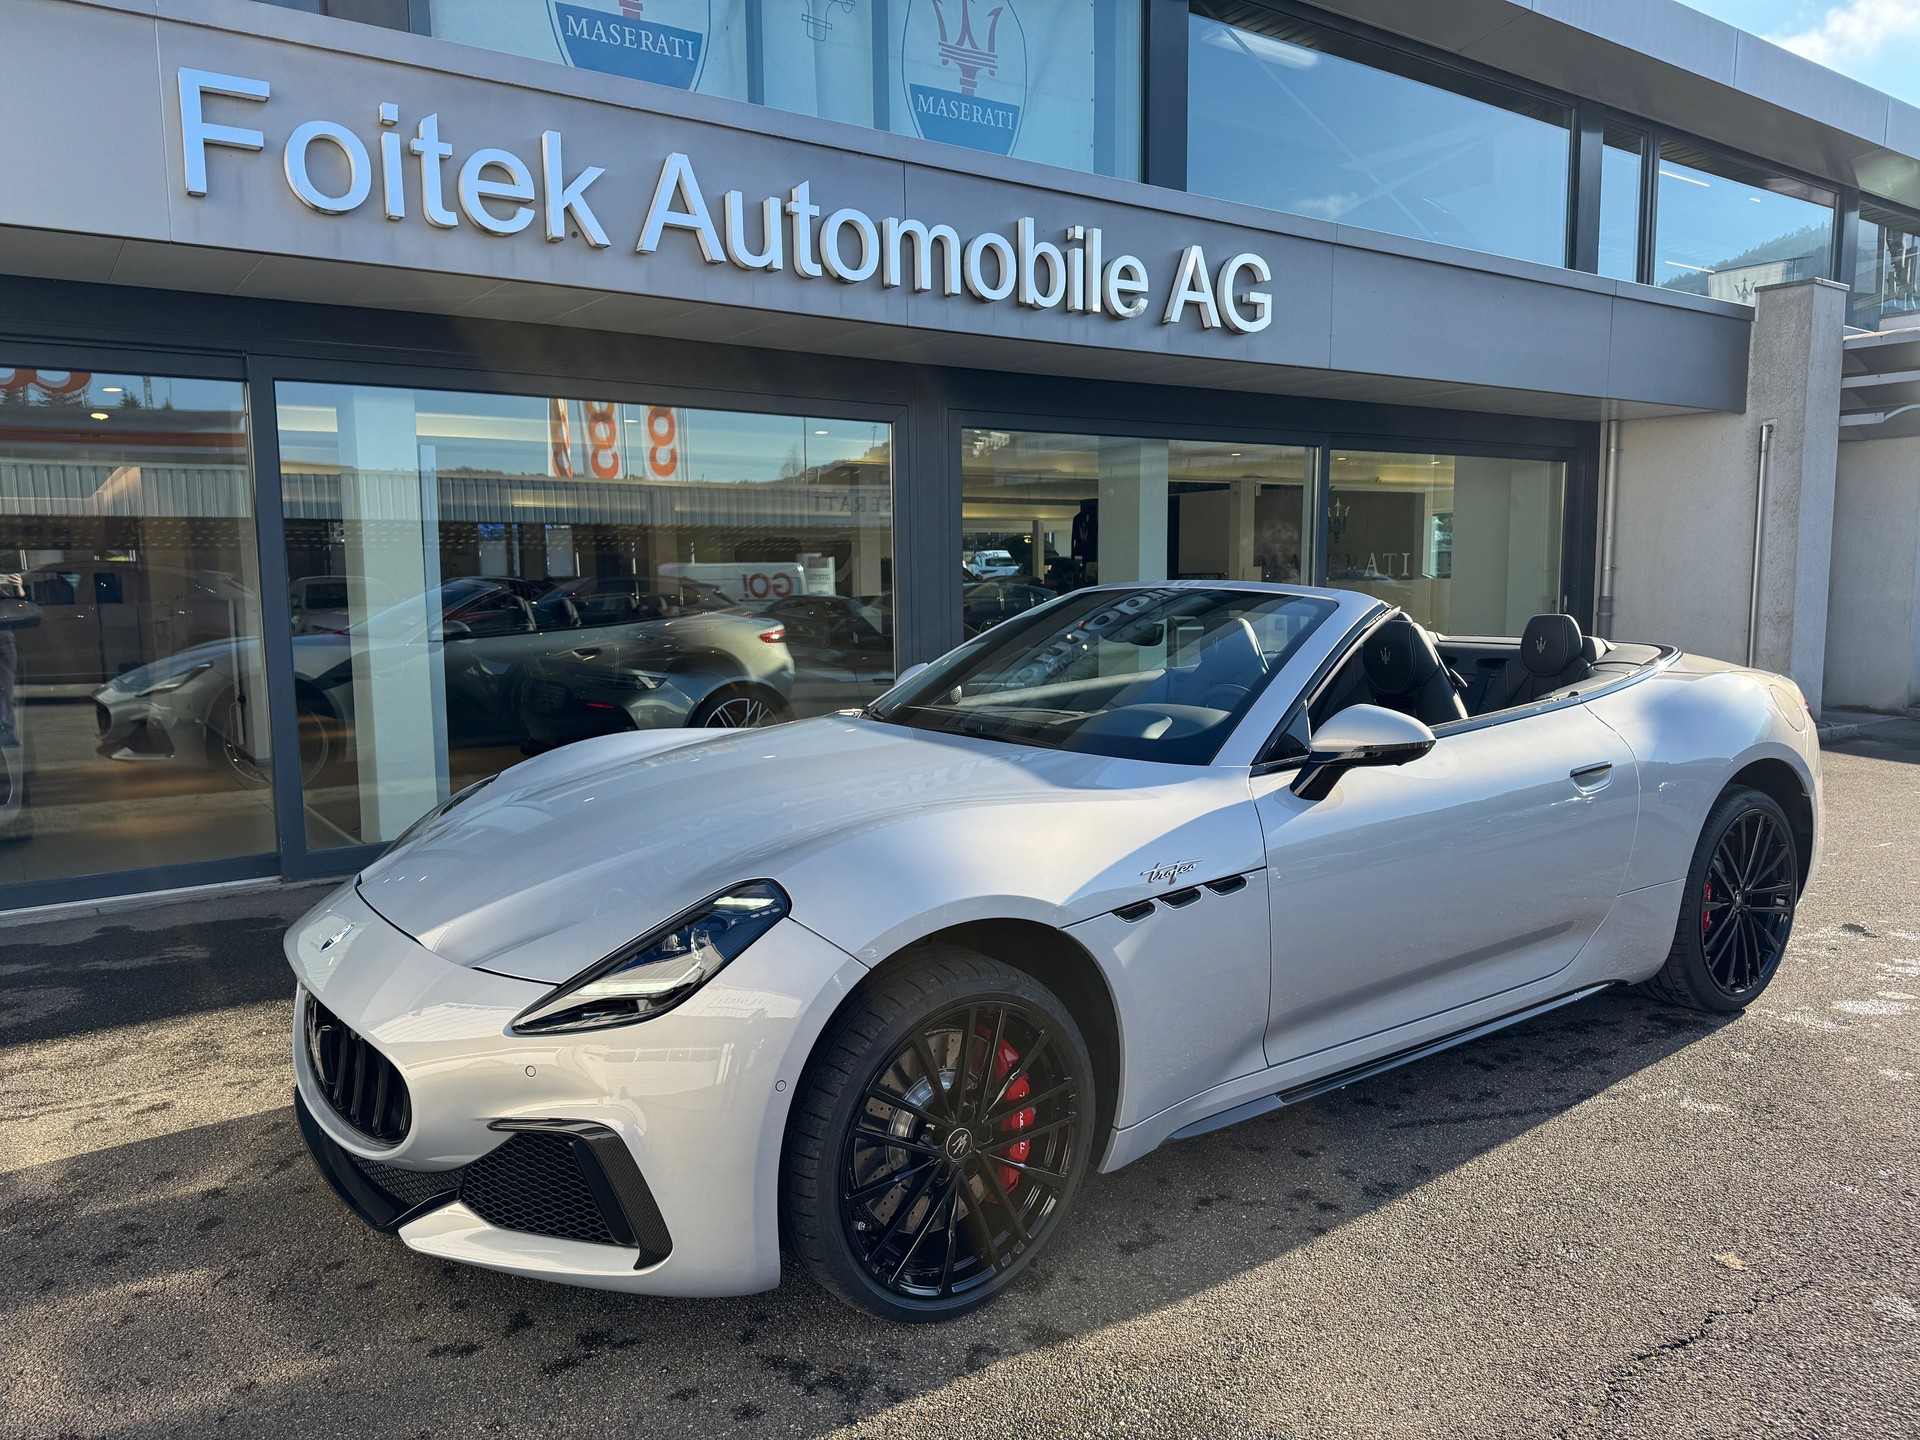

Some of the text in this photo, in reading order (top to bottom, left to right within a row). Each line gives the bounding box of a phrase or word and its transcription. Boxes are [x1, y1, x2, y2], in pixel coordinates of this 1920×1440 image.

[566, 14, 695, 61] MASERATI
[917, 93, 1014, 130] MASERATI
[177, 66, 1272, 334] Foitek Automobile AG
